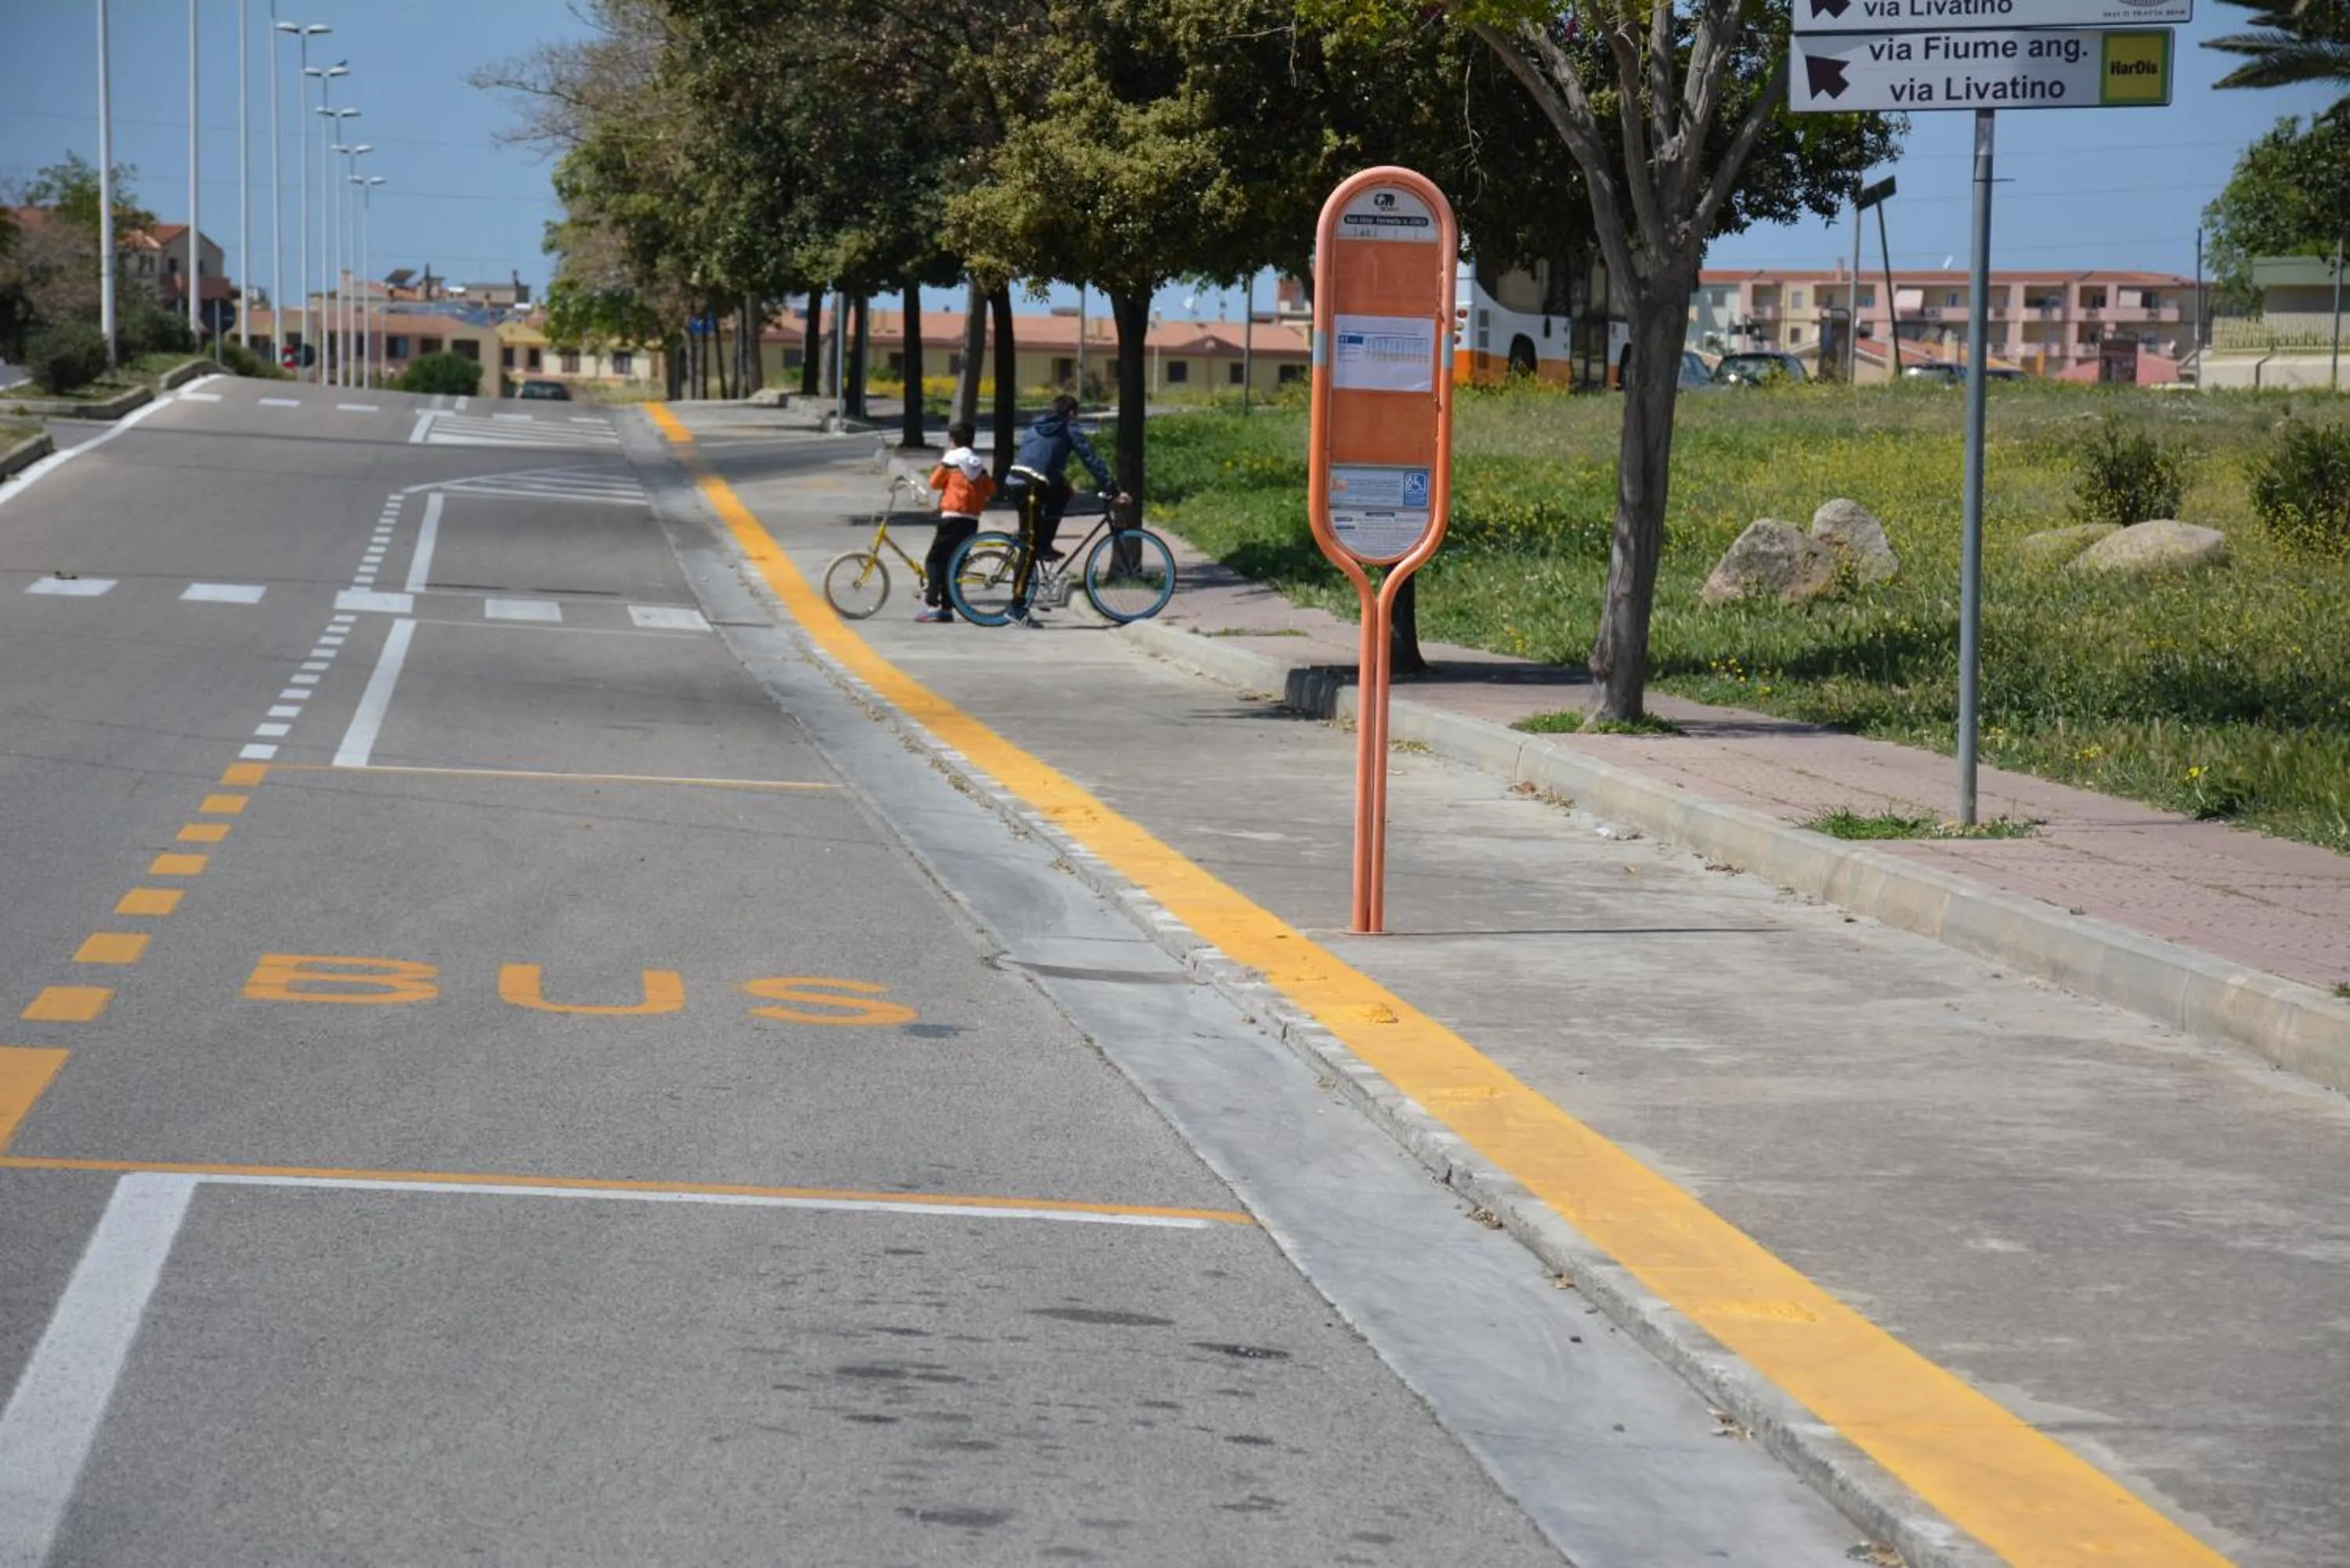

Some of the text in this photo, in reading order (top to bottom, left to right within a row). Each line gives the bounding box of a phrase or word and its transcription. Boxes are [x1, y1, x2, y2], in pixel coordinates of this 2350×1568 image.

[1864, 0, 2012, 17] via Livatino
[1869, 36, 2088, 63] via Fiume ang.
[1890, 75, 2066, 102] via Livatino
[240, 952, 919, 1027] BUS
